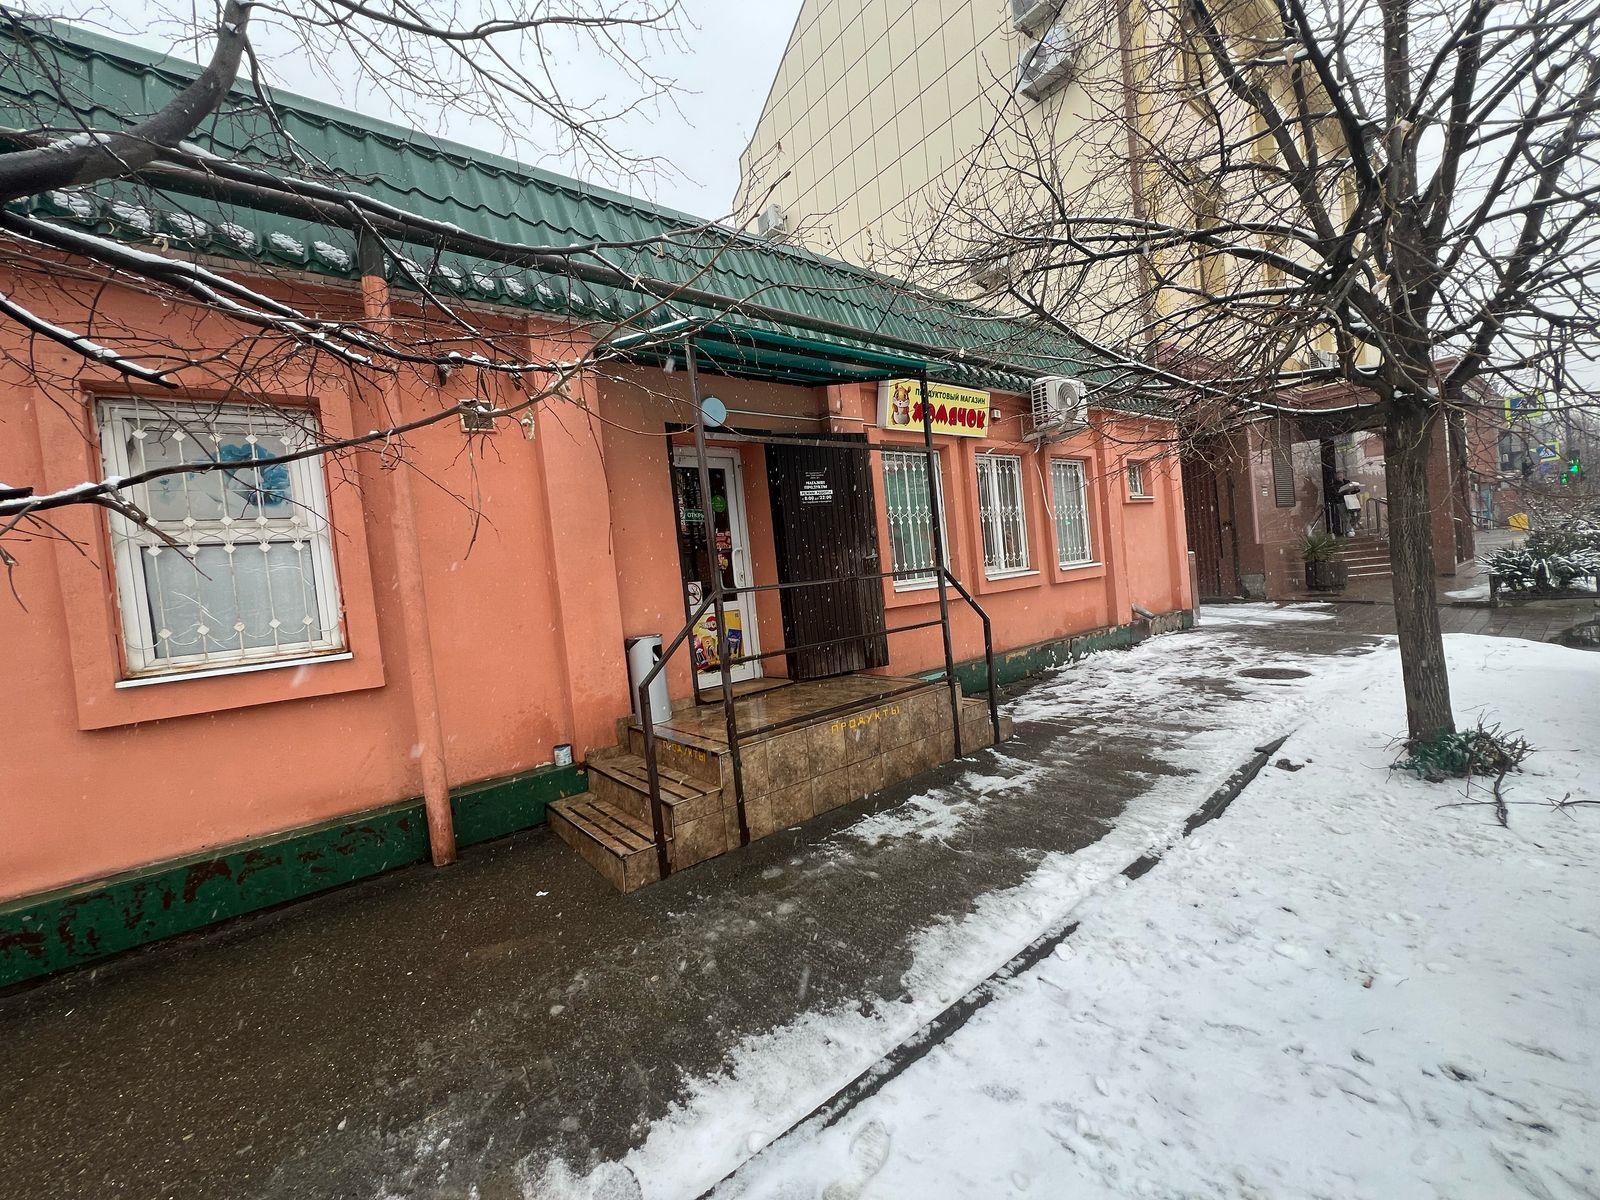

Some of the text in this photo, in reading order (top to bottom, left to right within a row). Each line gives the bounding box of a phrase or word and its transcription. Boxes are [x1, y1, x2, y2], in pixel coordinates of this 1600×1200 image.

[914, 388, 986, 405] ПДУКТОВЫЙ МАГАЗИН
[831, 705, 900, 734] ПРОДУКТЫ
